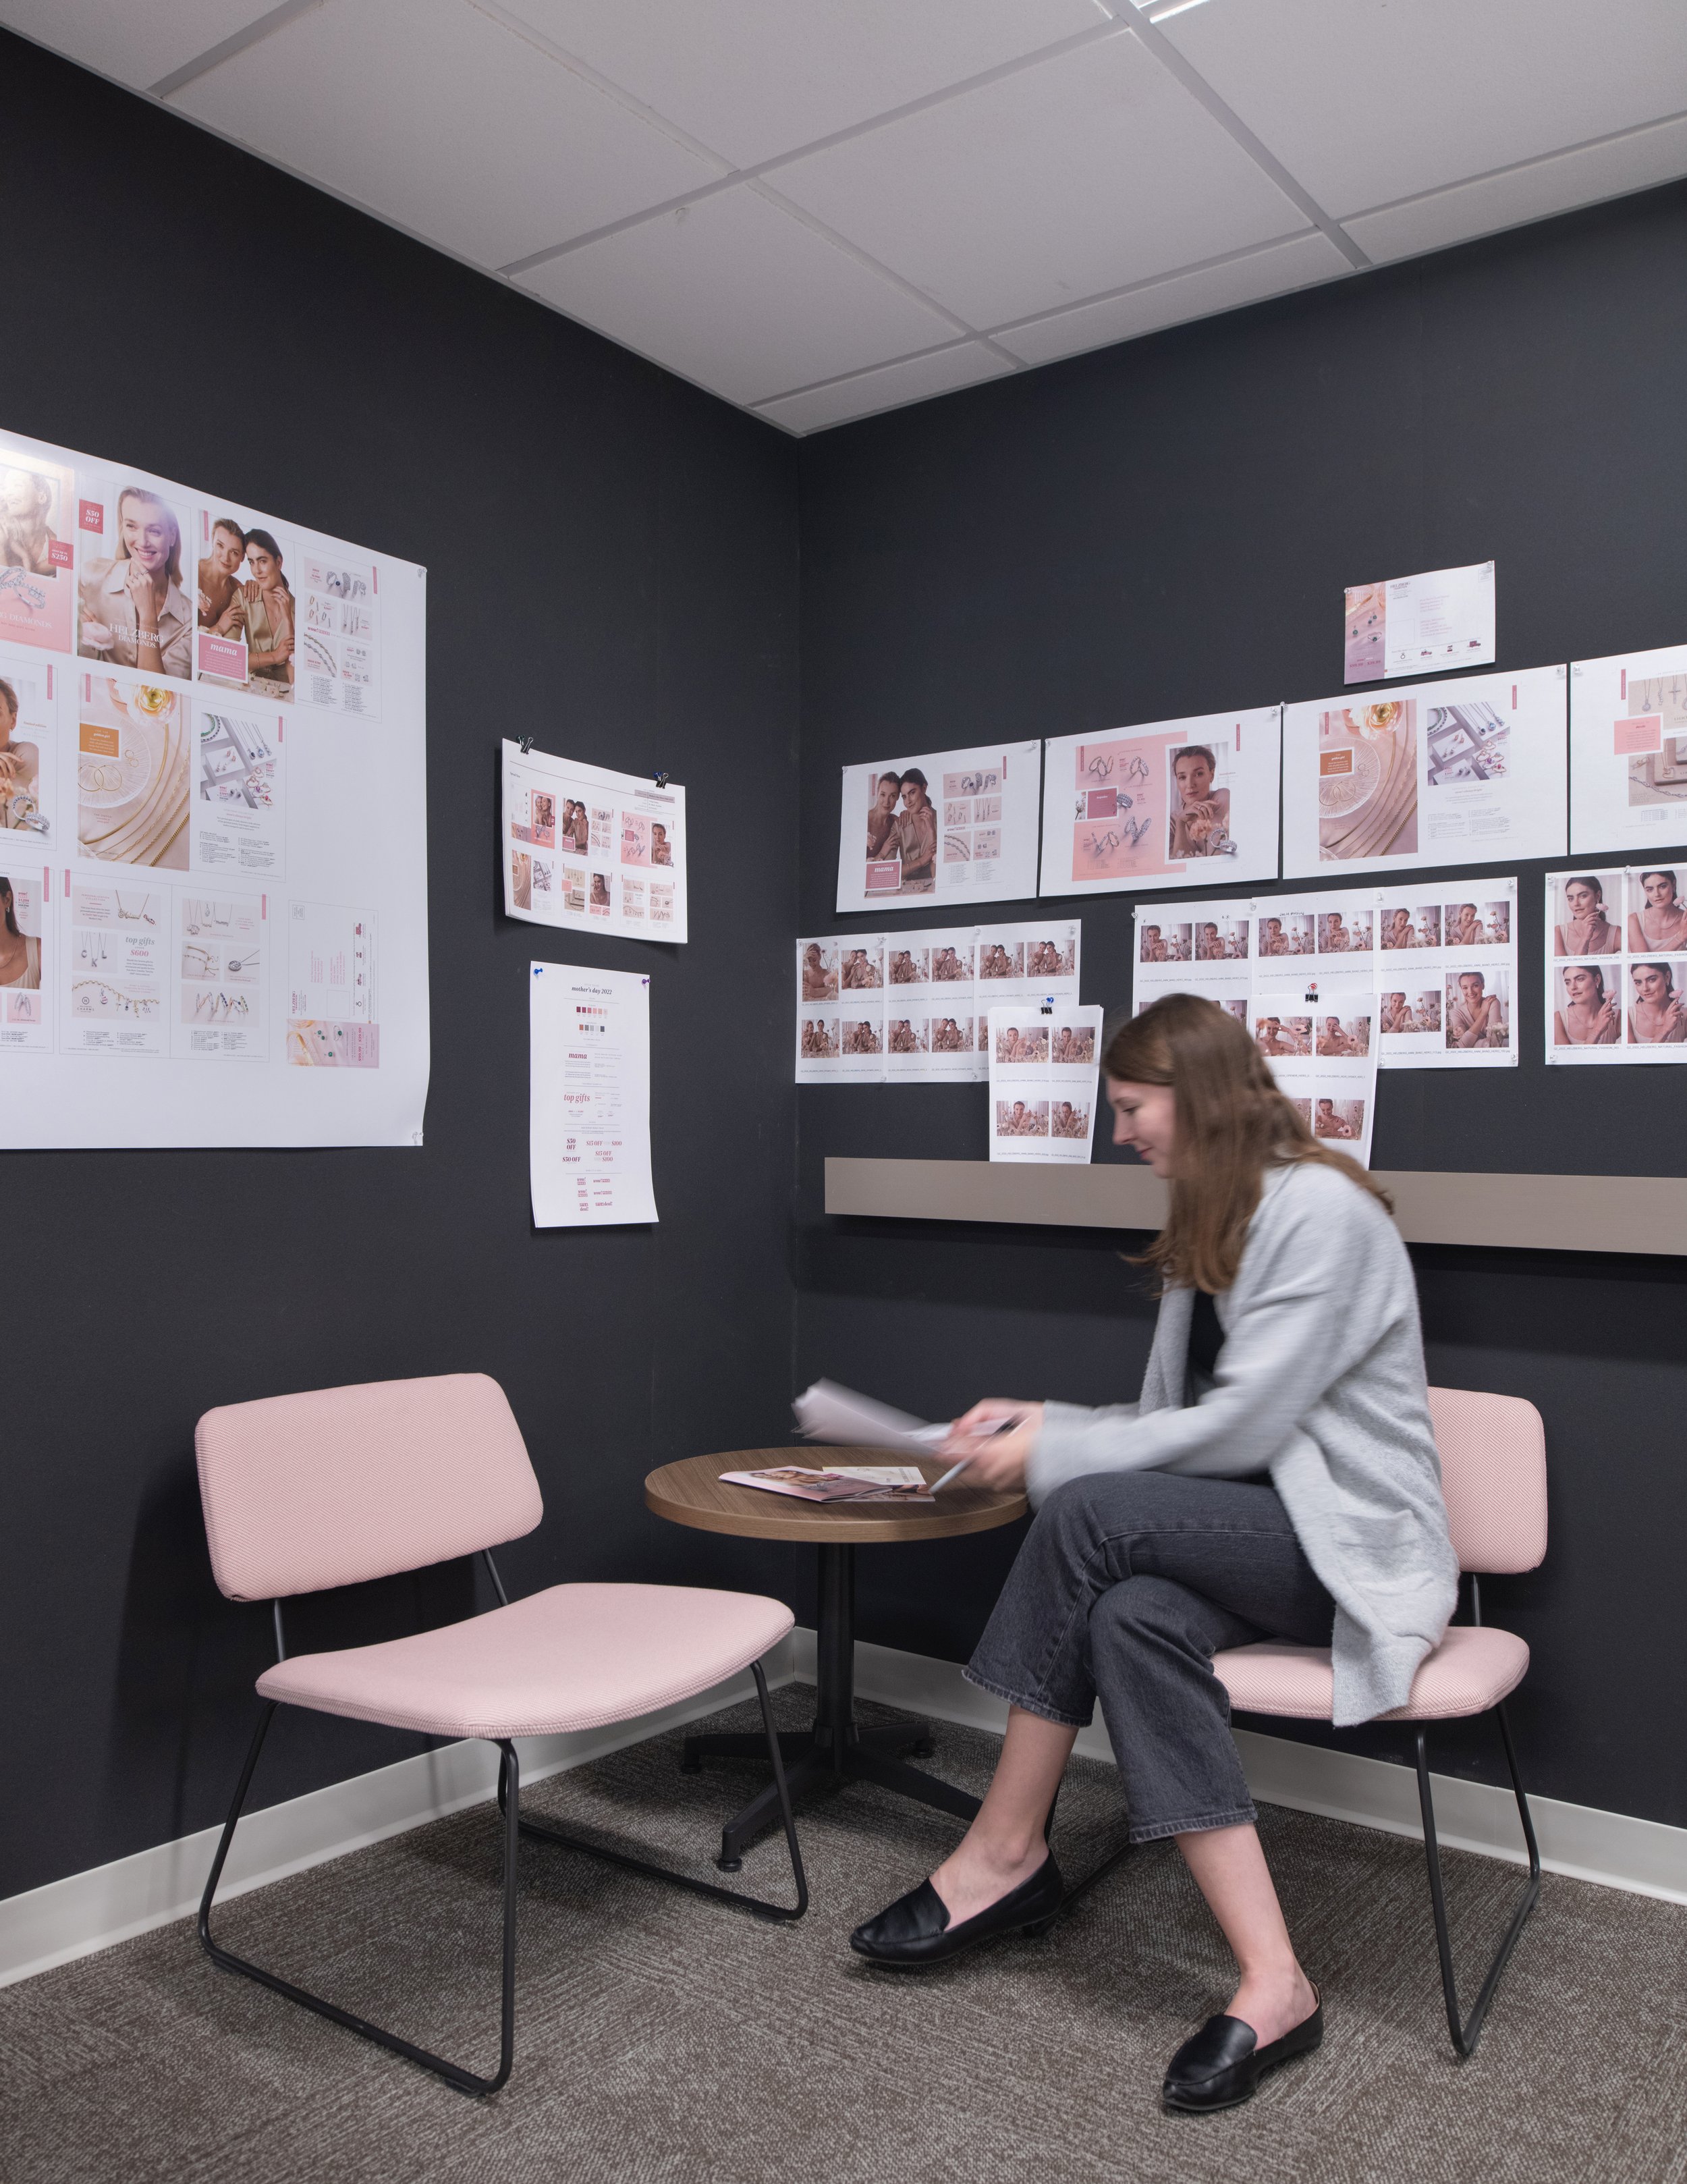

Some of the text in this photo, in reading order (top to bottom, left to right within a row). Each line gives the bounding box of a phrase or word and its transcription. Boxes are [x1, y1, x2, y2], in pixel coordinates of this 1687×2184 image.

[86, 509, 100, 518] $50
[85, 516, 100, 524] OFF
[51, 553, 67, 562] $250
[9, 613, 53, 628] DIAMONDS
[109, 623, 164, 643] HELZBERG
[210, 643, 238, 656] mama
[126, 936, 155, 946] top gifts
[563, 1093, 590, 1103] top gifts
